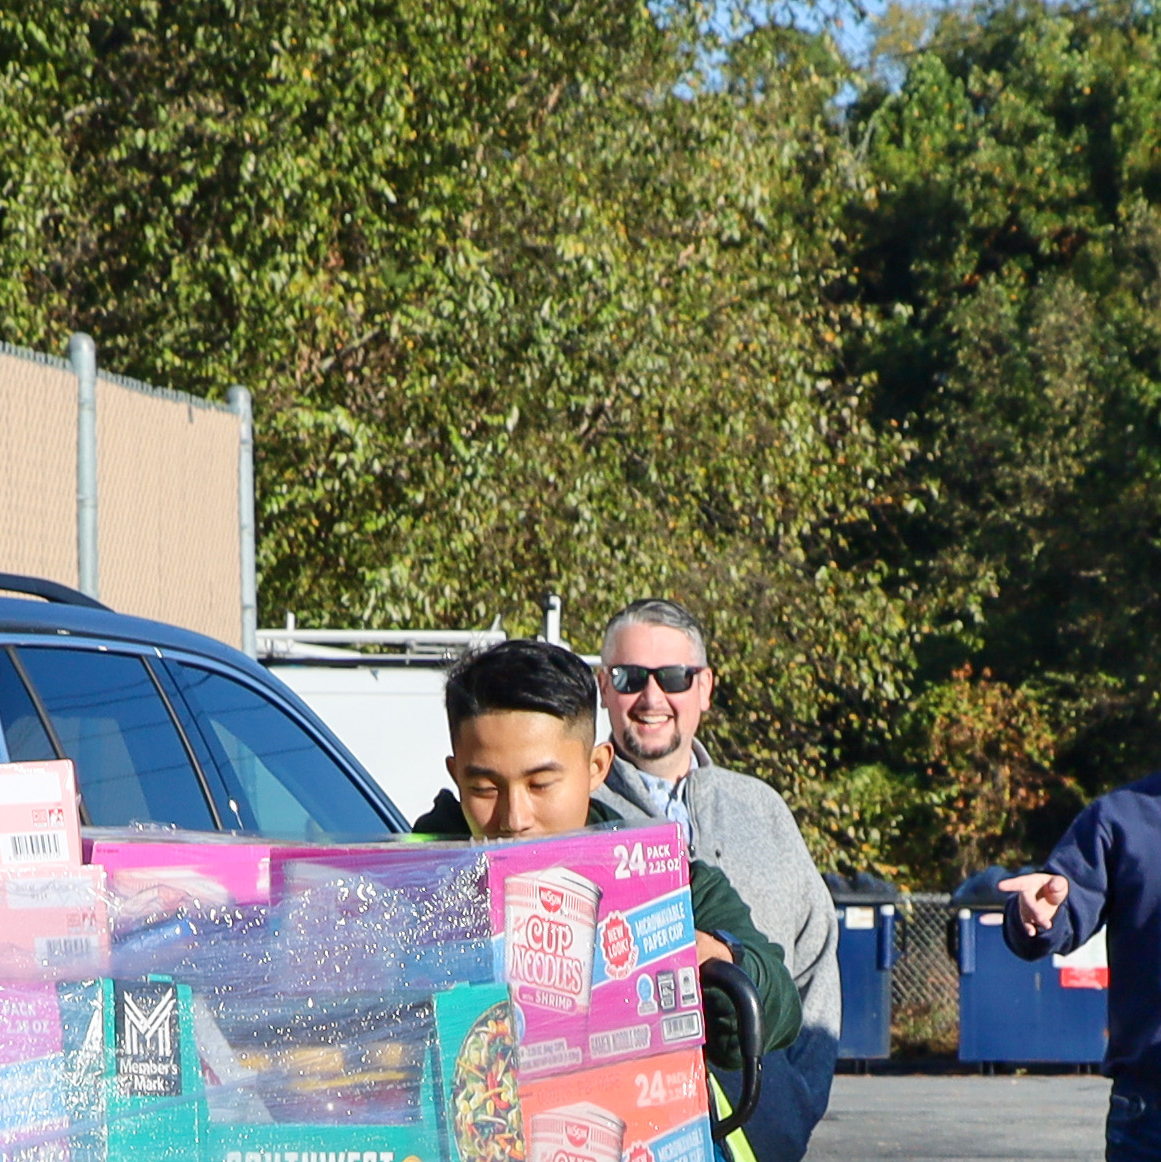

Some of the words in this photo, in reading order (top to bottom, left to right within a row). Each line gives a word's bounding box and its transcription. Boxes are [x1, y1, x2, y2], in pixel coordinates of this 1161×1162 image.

[614, 842, 647, 880] 24
[647, 844, 671, 859] PACK
[649, 859, 667, 873] 2.25
[667, 857, 680, 872] OZ
[526, 914, 574, 957] CUP
[608, 926, 624, 943] NEW
[642, 928, 668, 954] PAPER
[668, 921, 684, 942] CUP
[608, 938, 630, 958] LOOK!
[511, 949, 584, 996] NOODLES
[4, 1001, 36, 1016] PACK
[536, 989, 573, 1011] SHRIMP
[120, 1056, 178, 1075] Member's
[134, 1075, 165, 1092] Mark
[635, 1070, 667, 1107] 24
